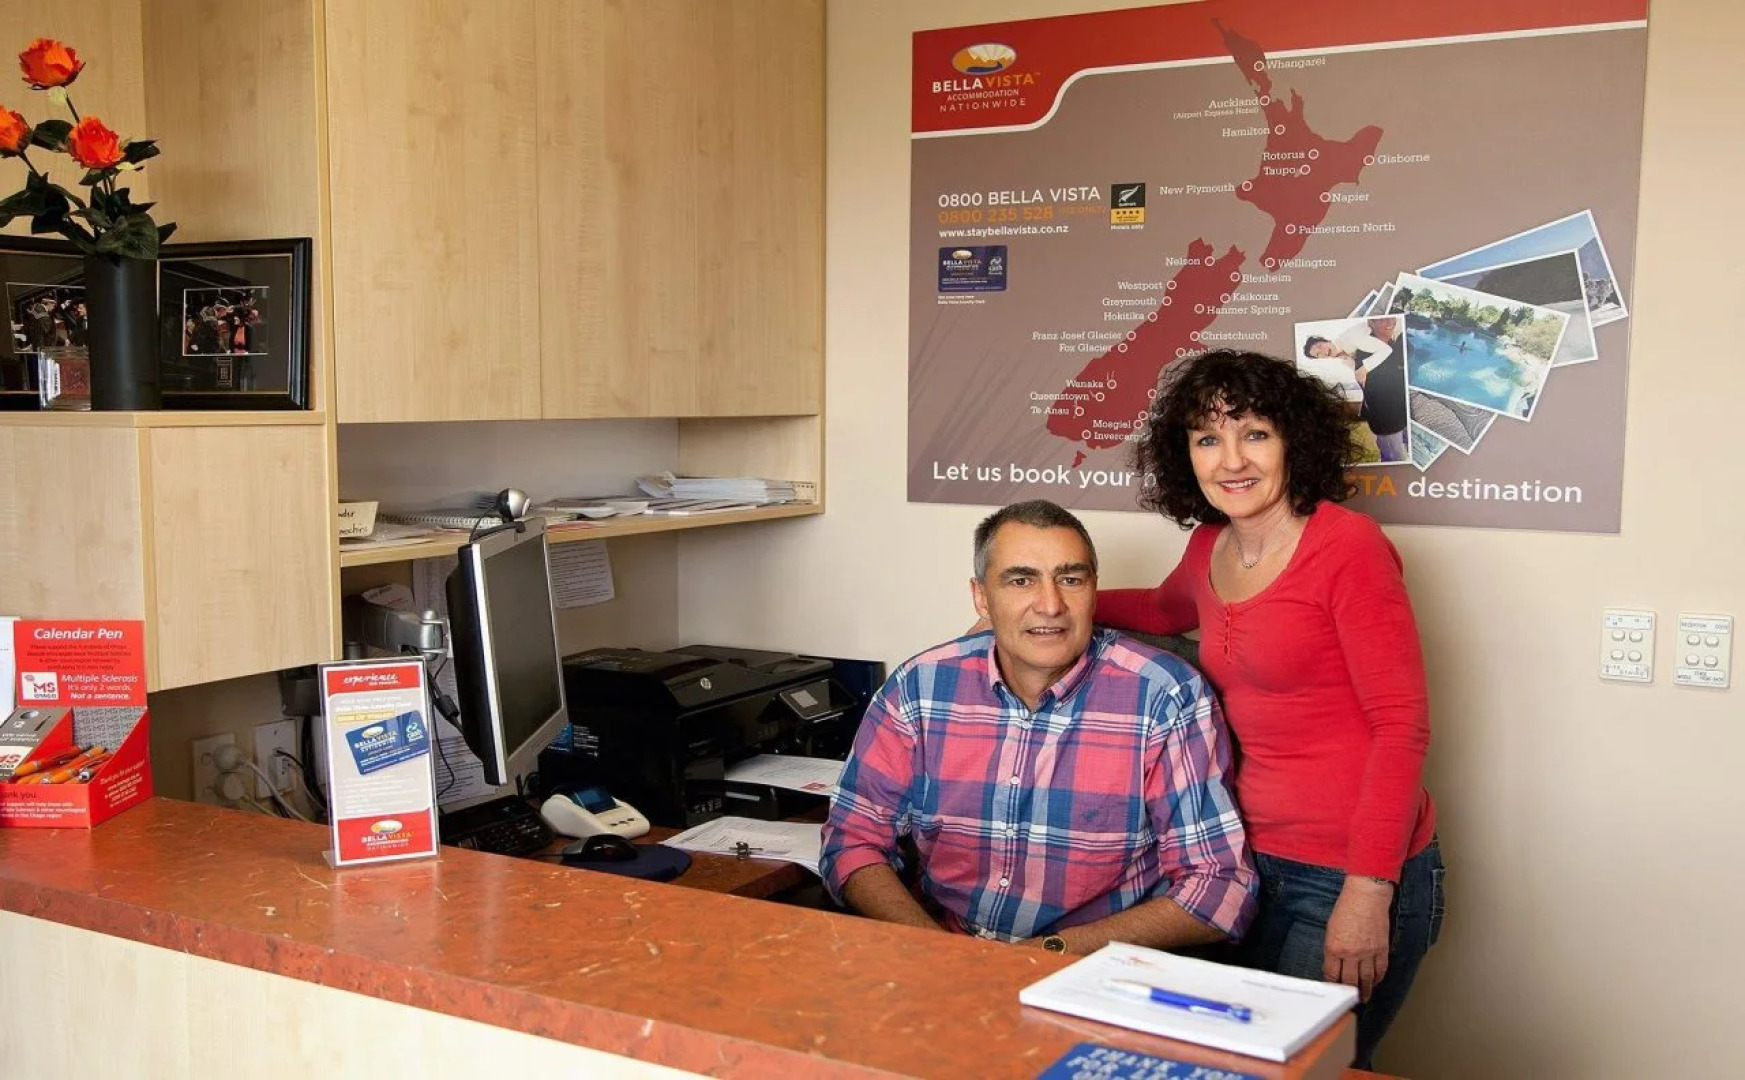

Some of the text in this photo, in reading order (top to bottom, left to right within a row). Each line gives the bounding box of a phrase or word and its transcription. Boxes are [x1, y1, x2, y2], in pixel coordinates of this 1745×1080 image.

[1266, 58, 1327, 70] Whangarei
[932, 73, 1034, 94] BELLA VISTA
[947, 88, 1019, 102] ACCOMMODATION
[940, 97, 1027, 112] NATIONWIDE
[1208, 97, 1259, 109] Auckland
[1222, 126, 1270, 137] Hamilton
[1263, 151, 1305, 161] Rotorua
[1377, 153, 1431, 164] Gisborne
[1263, 165, 1296, 177] Taupo
[1159, 182, 1235, 196] New Plymouth
[938, 186, 1101, 207] 0800 BELLA VISTA
[1332, 193, 1370, 204] Napier
[938, 208, 982, 224] 0800
[938, 224, 1069, 239] www.staybellavista.co.nz
[1299, 222, 1396, 234] Palmerston North
[1166, 257, 1201, 266] Nelson
[1278, 258, 1337, 269] Wellington
[1242, 273, 1292, 283] Blenheim
[1118, 281, 1163, 291] Westport
[1232, 292, 1280, 301] Kaikoura
[1102, 297, 1157, 308] Greymouth
[1104, 312, 1145, 321] Hokitika
[1206, 305, 1291, 317] Hanmer Springs
[1032, 330, 1122, 340] Franz Josef Glacier
[1201, 330, 1267, 340] Christchurch
[1059, 343, 1112, 352] Fox Glacier
[1066, 379, 1104, 388] Wanaka
[1030, 392, 1090, 401] Queenstown
[1031, 406, 1070, 415] Te Anau
[1093, 419, 1131, 430] Mosgiel
[933, 461, 969, 481] Let
[976, 466, 1002, 482] us
[1009, 463, 1071, 484] book
[1079, 469, 1135, 489] your
[1407, 476, 1583, 503] destination
[34, 628, 123, 639] Calendar Pen
[61, 674, 139, 684] Multiple Sclerosis
[34, 682, 56, 693] MS
[67, 683, 79, 691] It's
[81, 683, 98, 692] only
[99, 683, 105, 691] 2
[70, 692, 87, 700] Not
[20, 792, 36, 800] you
